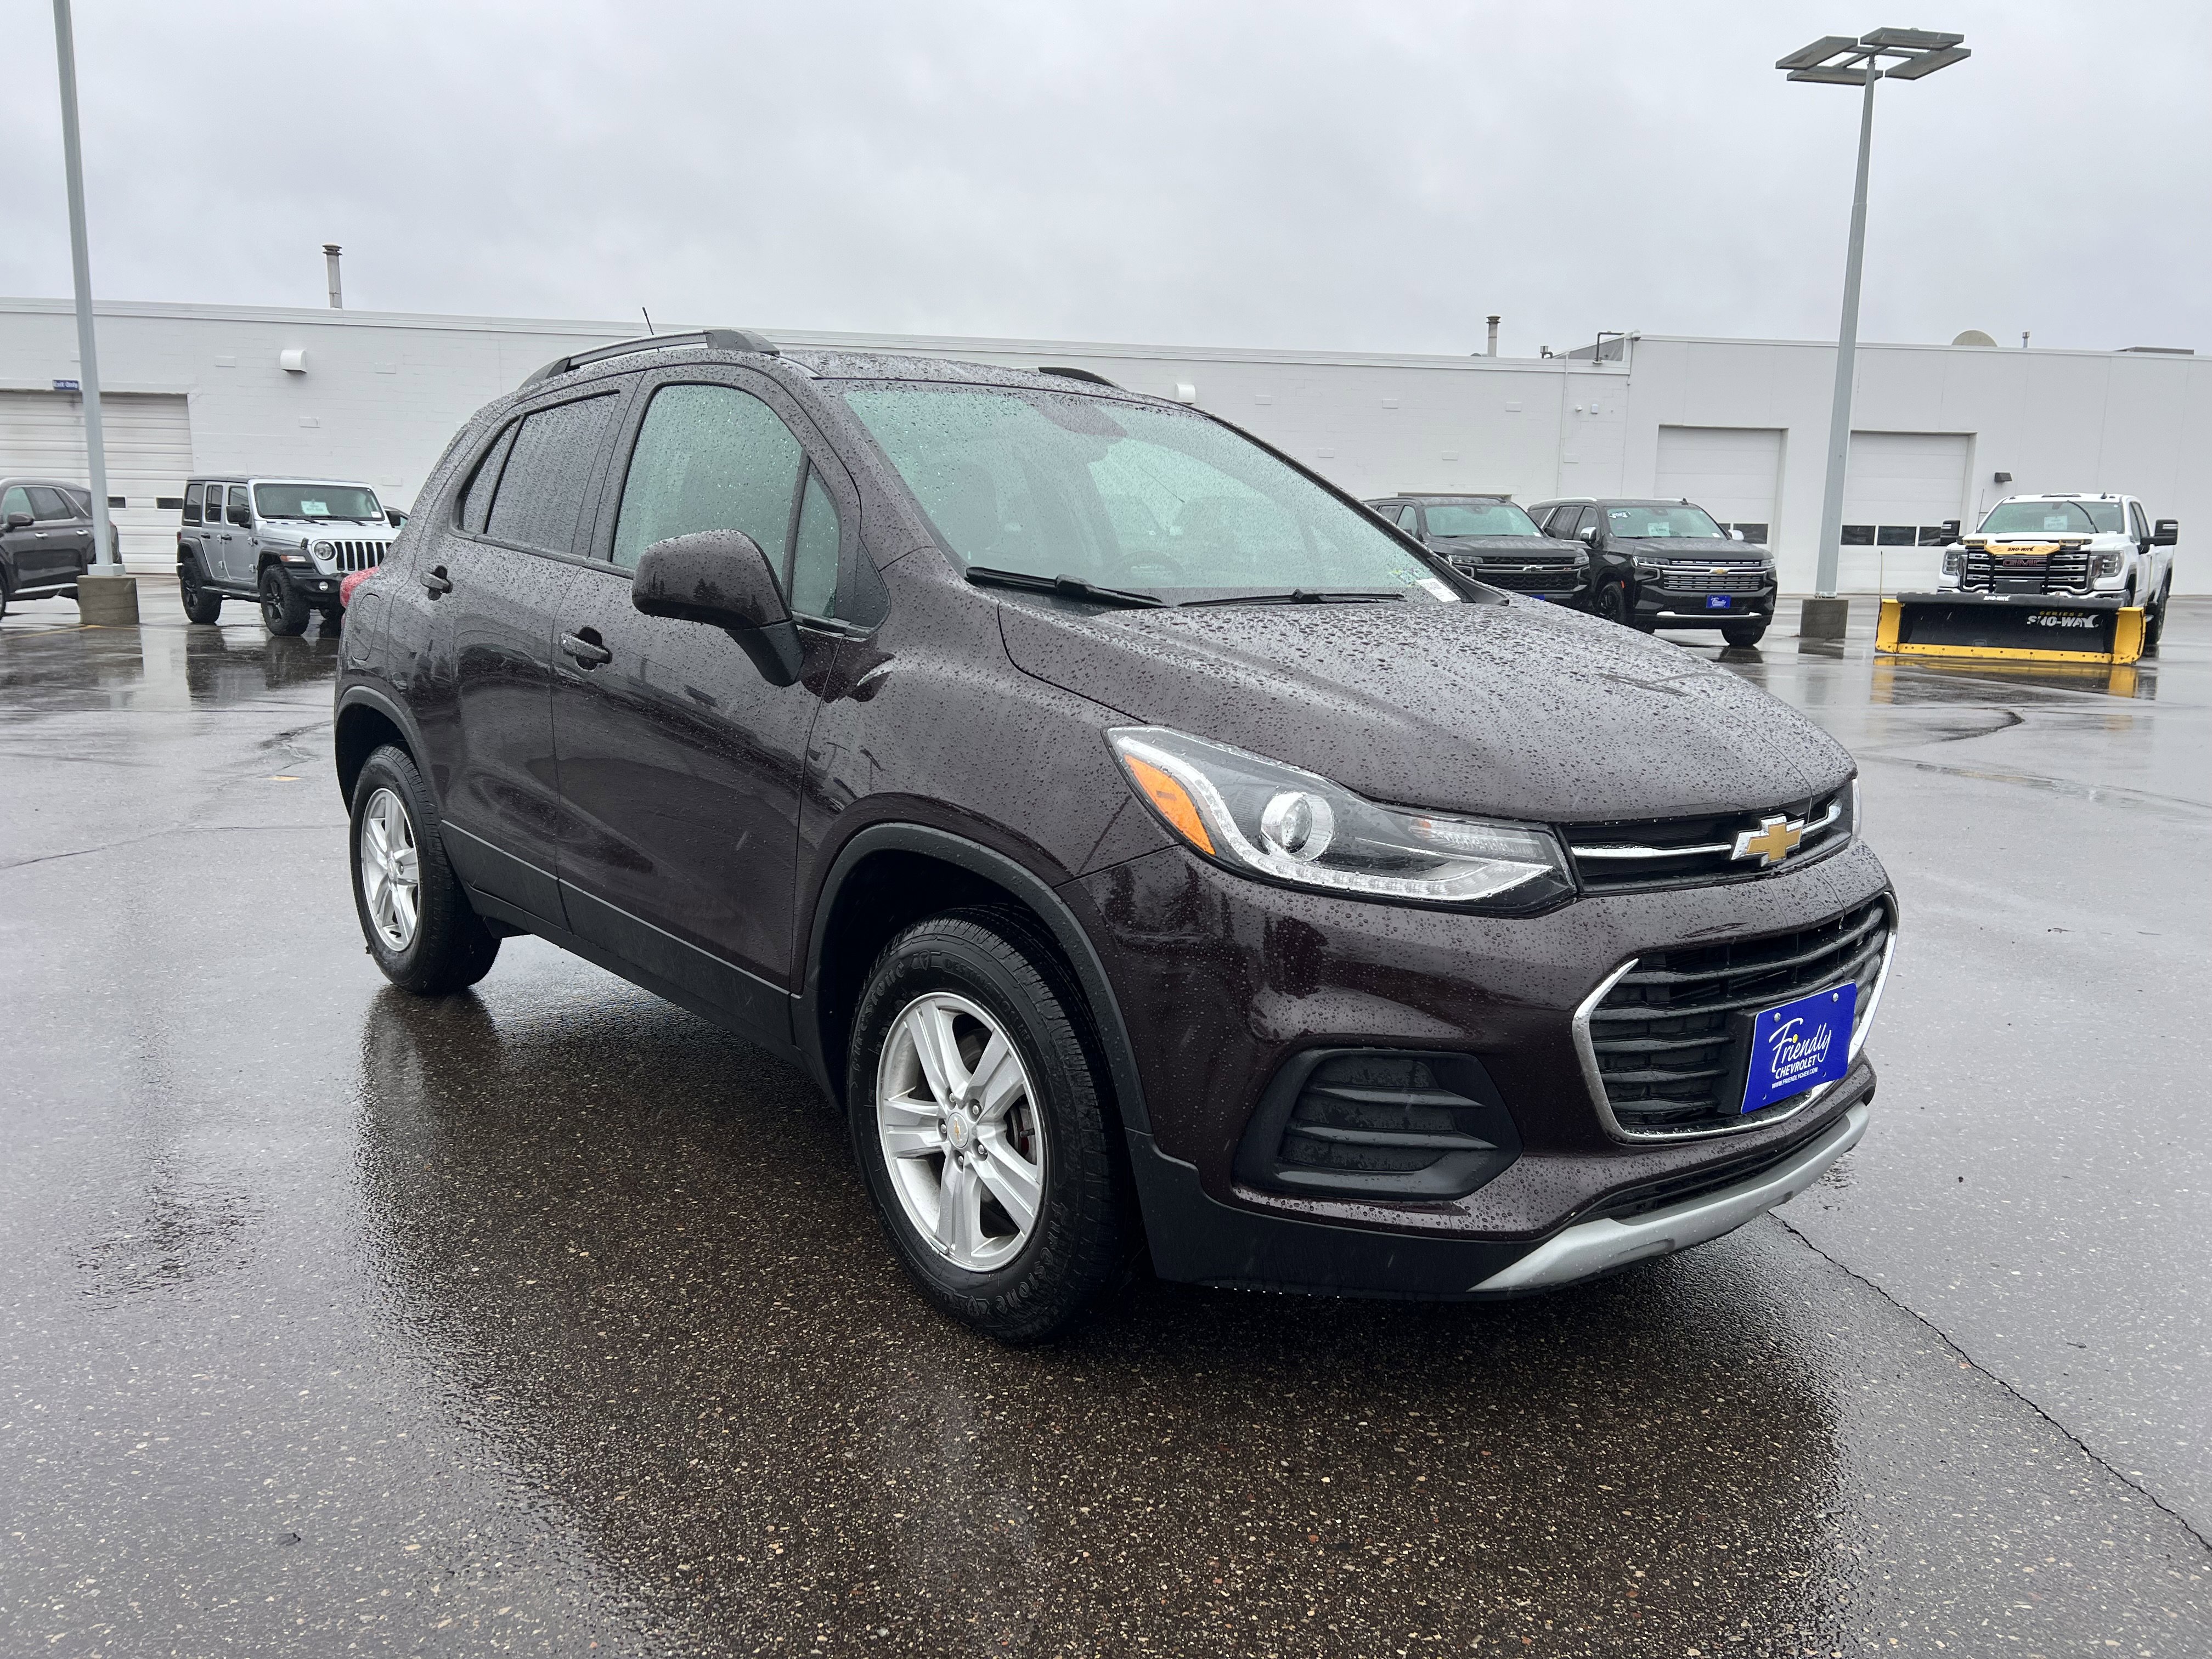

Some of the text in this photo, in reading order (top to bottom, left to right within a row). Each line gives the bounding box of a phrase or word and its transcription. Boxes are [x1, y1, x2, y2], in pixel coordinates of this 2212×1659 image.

[2002, 558, 2047, 567] GMC
[2027, 614, 2100, 628] SNO-WAY
[1768, 1017, 1832, 1073] Friendly
[1771, 1066, 1818, 1089] WWW.FRIENDLYCHEV.COM
[1775, 1054, 1818, 1079] CHEVROLET
